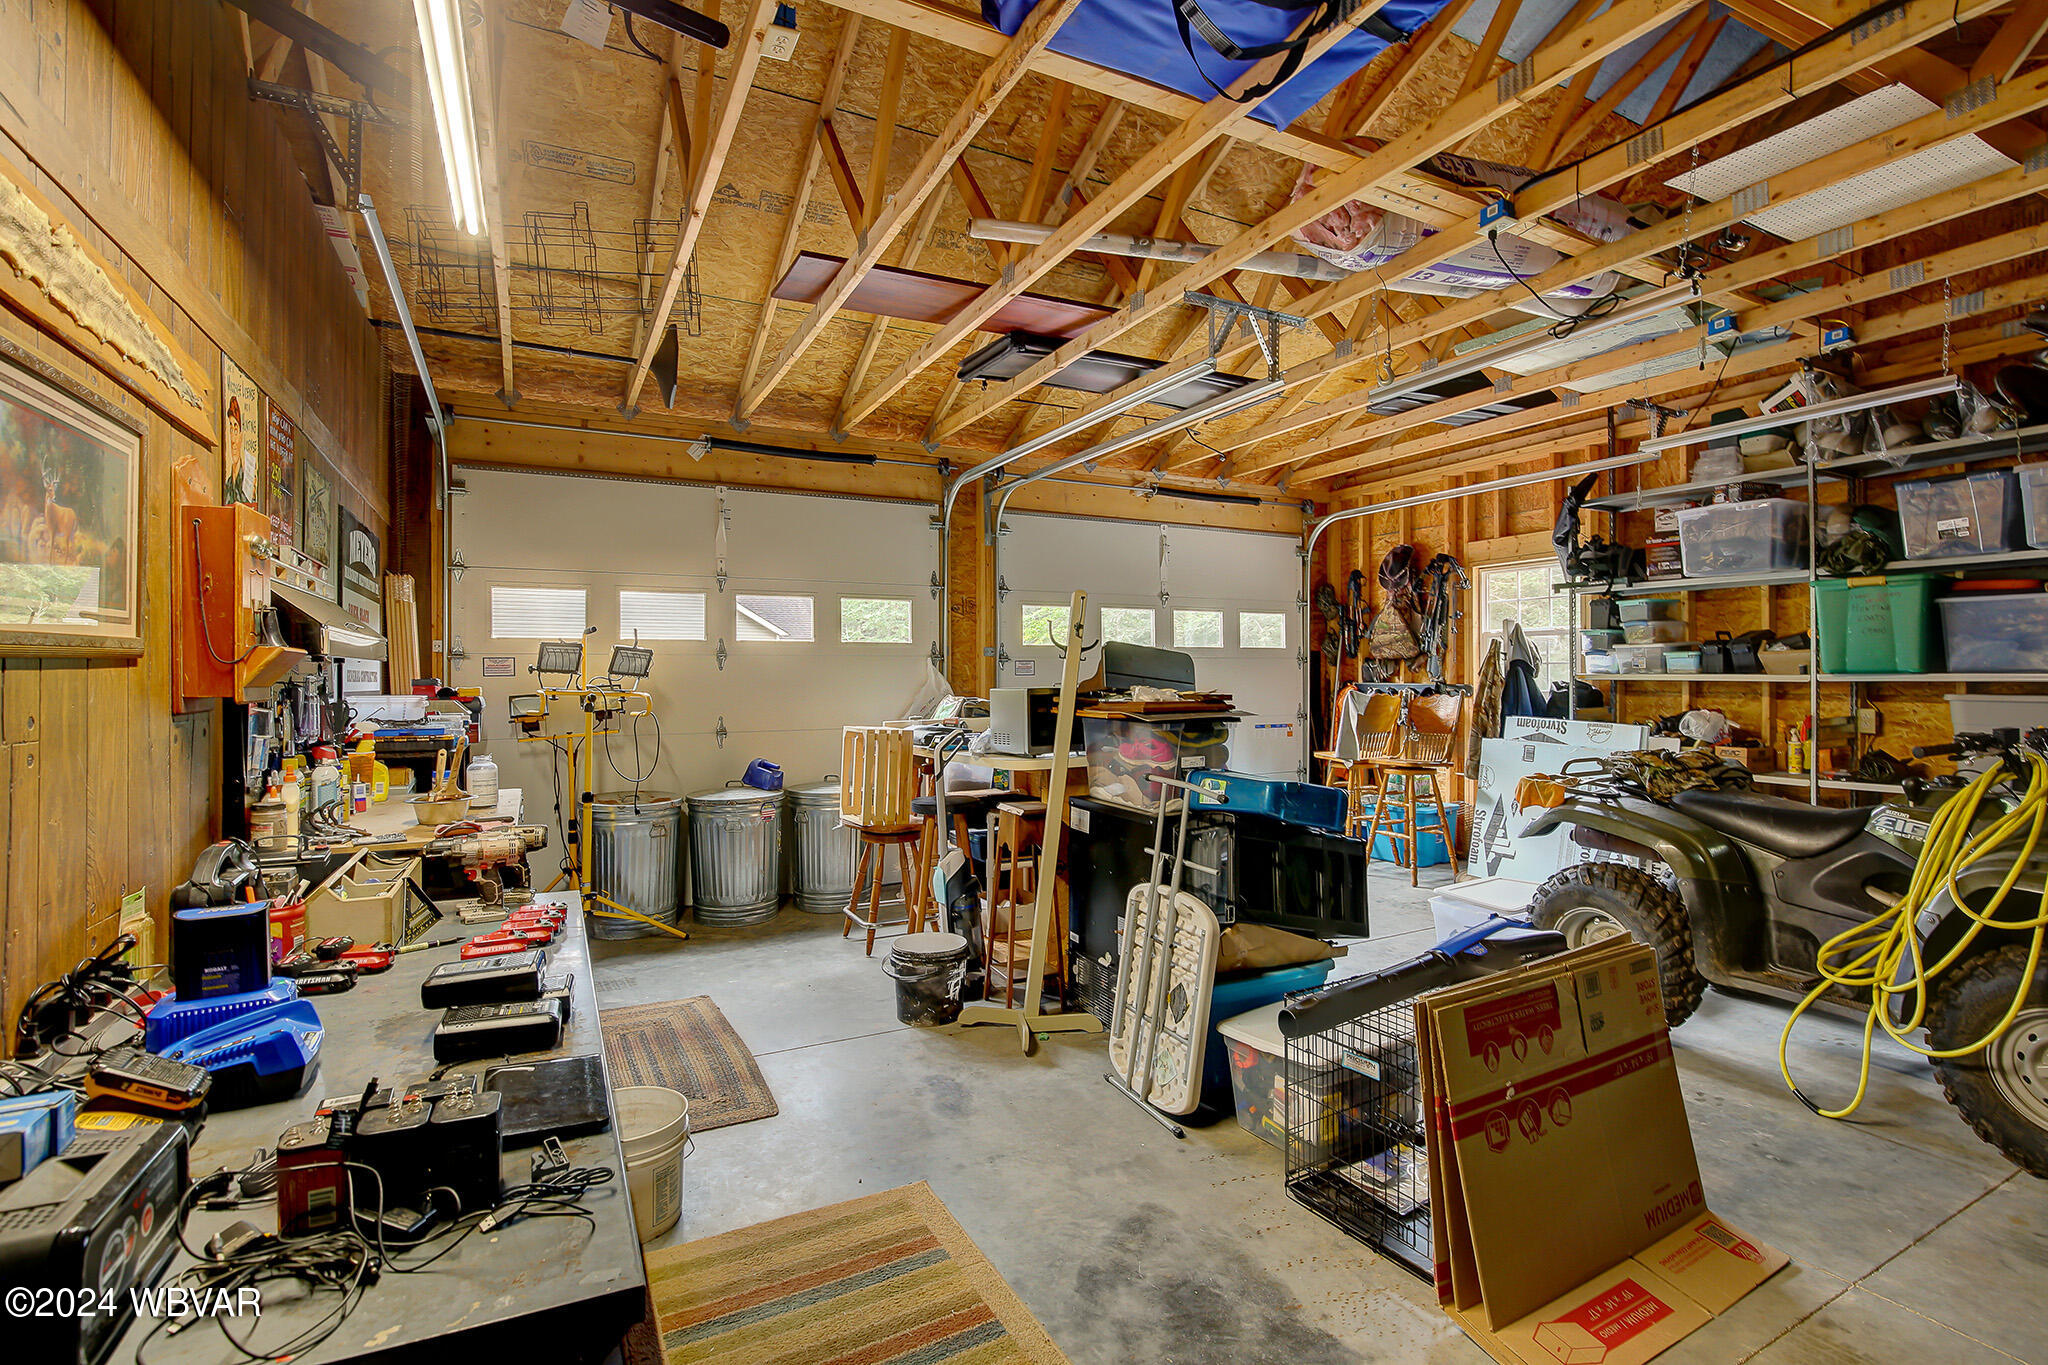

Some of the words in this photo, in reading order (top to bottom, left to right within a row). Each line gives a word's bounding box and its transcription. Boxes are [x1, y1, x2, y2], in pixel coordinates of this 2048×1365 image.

[1516, 717, 1568, 735] Styrofoam
[1469, 808, 1487, 864] Styrofoam
[1873, 815, 1928, 839] EIG
[294, 975, 332, 986] RAFTSMAN
[1643, 1190, 1692, 1231] MEDIUM
[1624, 1300, 1660, 1331] MEDIUM
[1599, 1320, 1621, 1339] MEDIO
